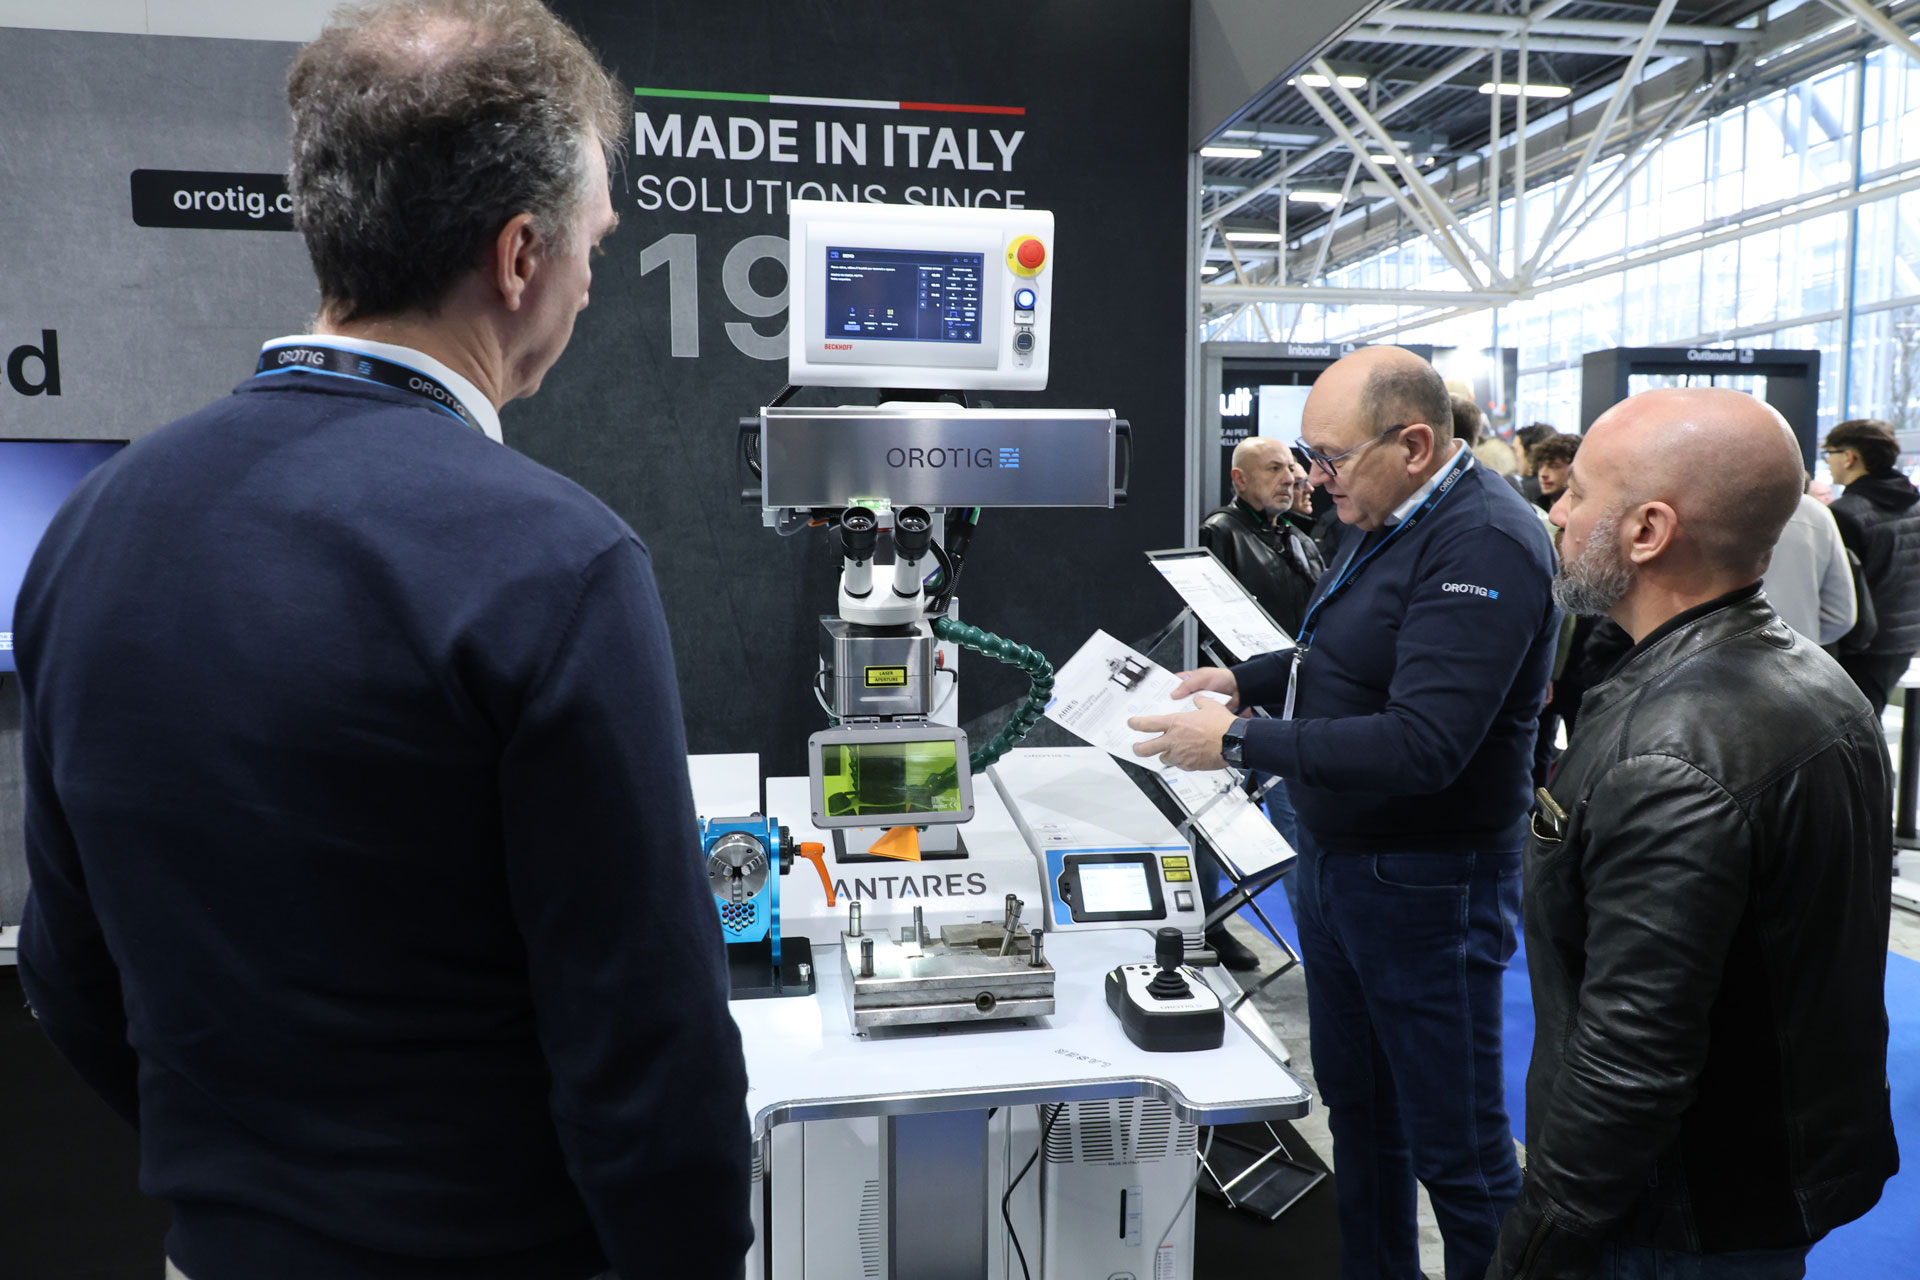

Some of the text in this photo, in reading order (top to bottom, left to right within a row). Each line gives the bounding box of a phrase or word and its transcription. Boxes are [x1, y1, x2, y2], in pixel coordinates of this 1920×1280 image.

[634, 112, 1026, 172] MADE IN ITALY
[278, 349, 325, 365] OROTIG
[824, 343, 853, 351] BECKHOFF
[1287, 344, 1331, 356] Inbound
[1686, 349, 1737, 361] Outbound
[0, 329, 61, 396] d
[408, 377, 467, 417] OROTIG
[886, 447, 993, 468] OROTIG
[1439, 467, 1462, 493] OROTIG
[1441, 582, 1488, 598] OROTIG
[834, 872, 987, 901] ANTARES
